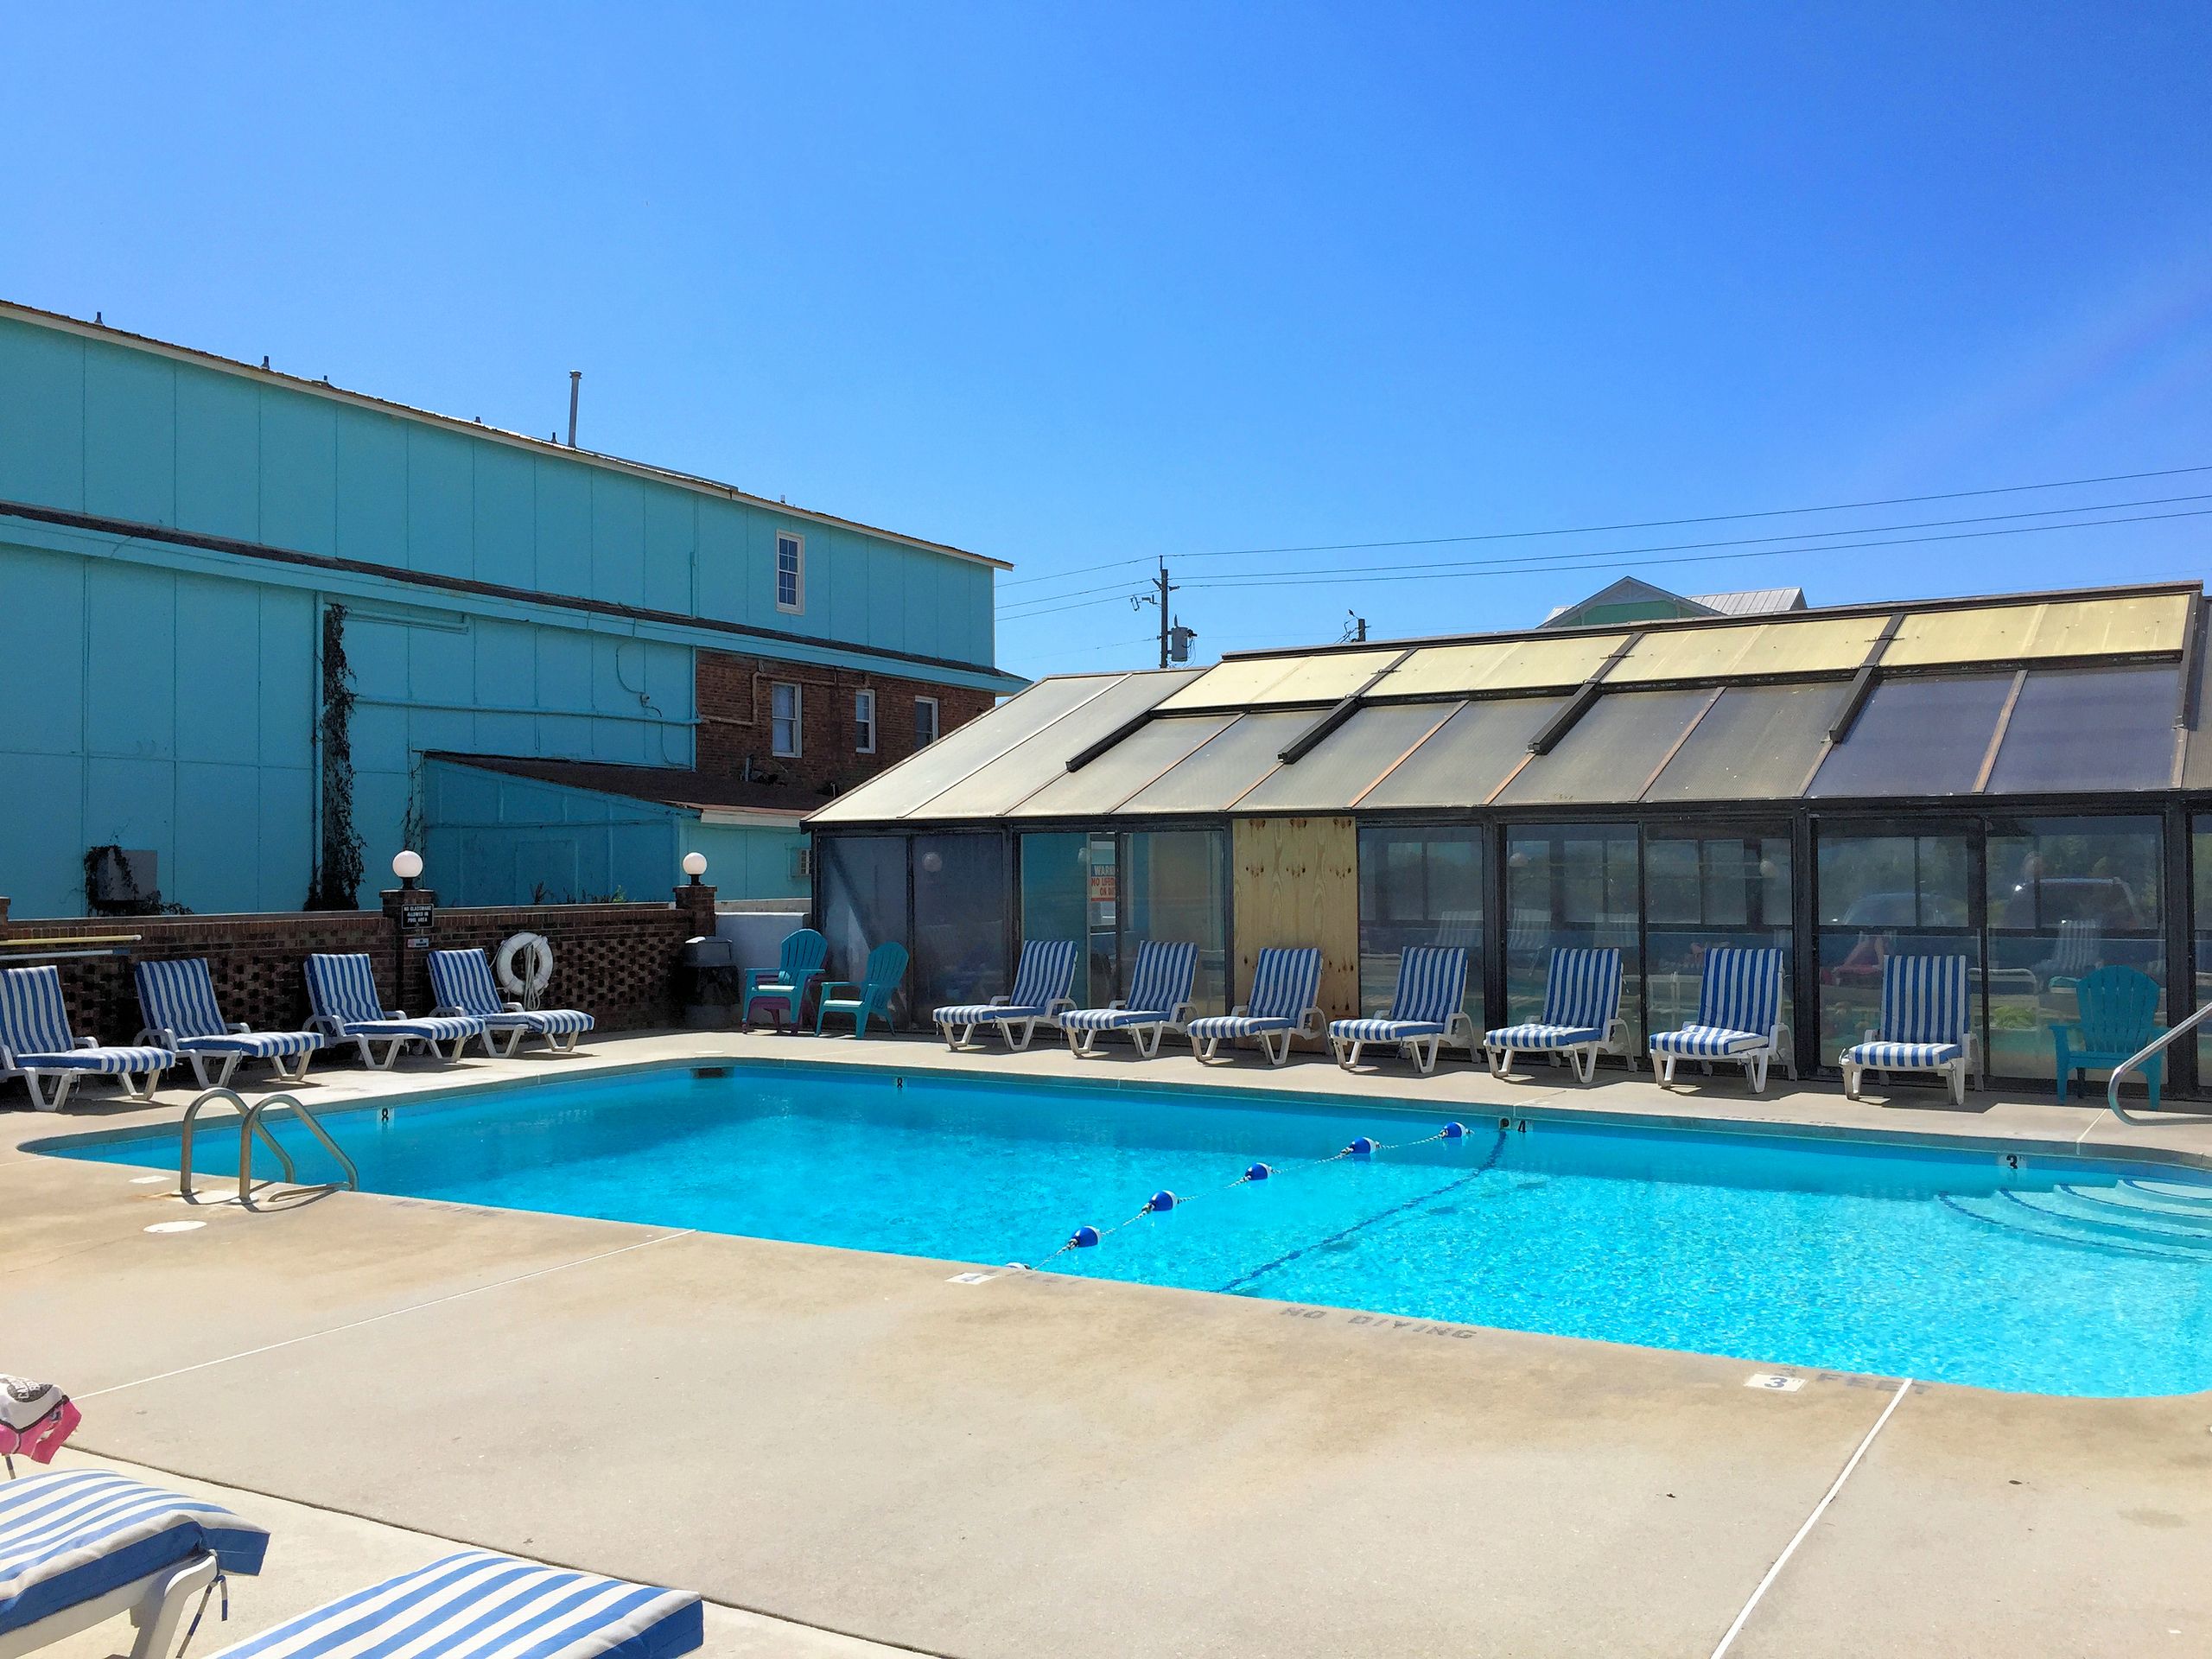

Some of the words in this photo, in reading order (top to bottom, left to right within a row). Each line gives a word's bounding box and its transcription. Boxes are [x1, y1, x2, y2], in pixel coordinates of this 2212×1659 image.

[1094, 865, 1116, 875] WARN
[1517, 1120, 1527, 1133] 4
[1280, 1306, 1327, 1319] NO
[1347, 1315, 1478, 1339] DIVING
[1764, 1377, 1788, 1388] 3
[1817, 1372, 1931, 1395] FEET
